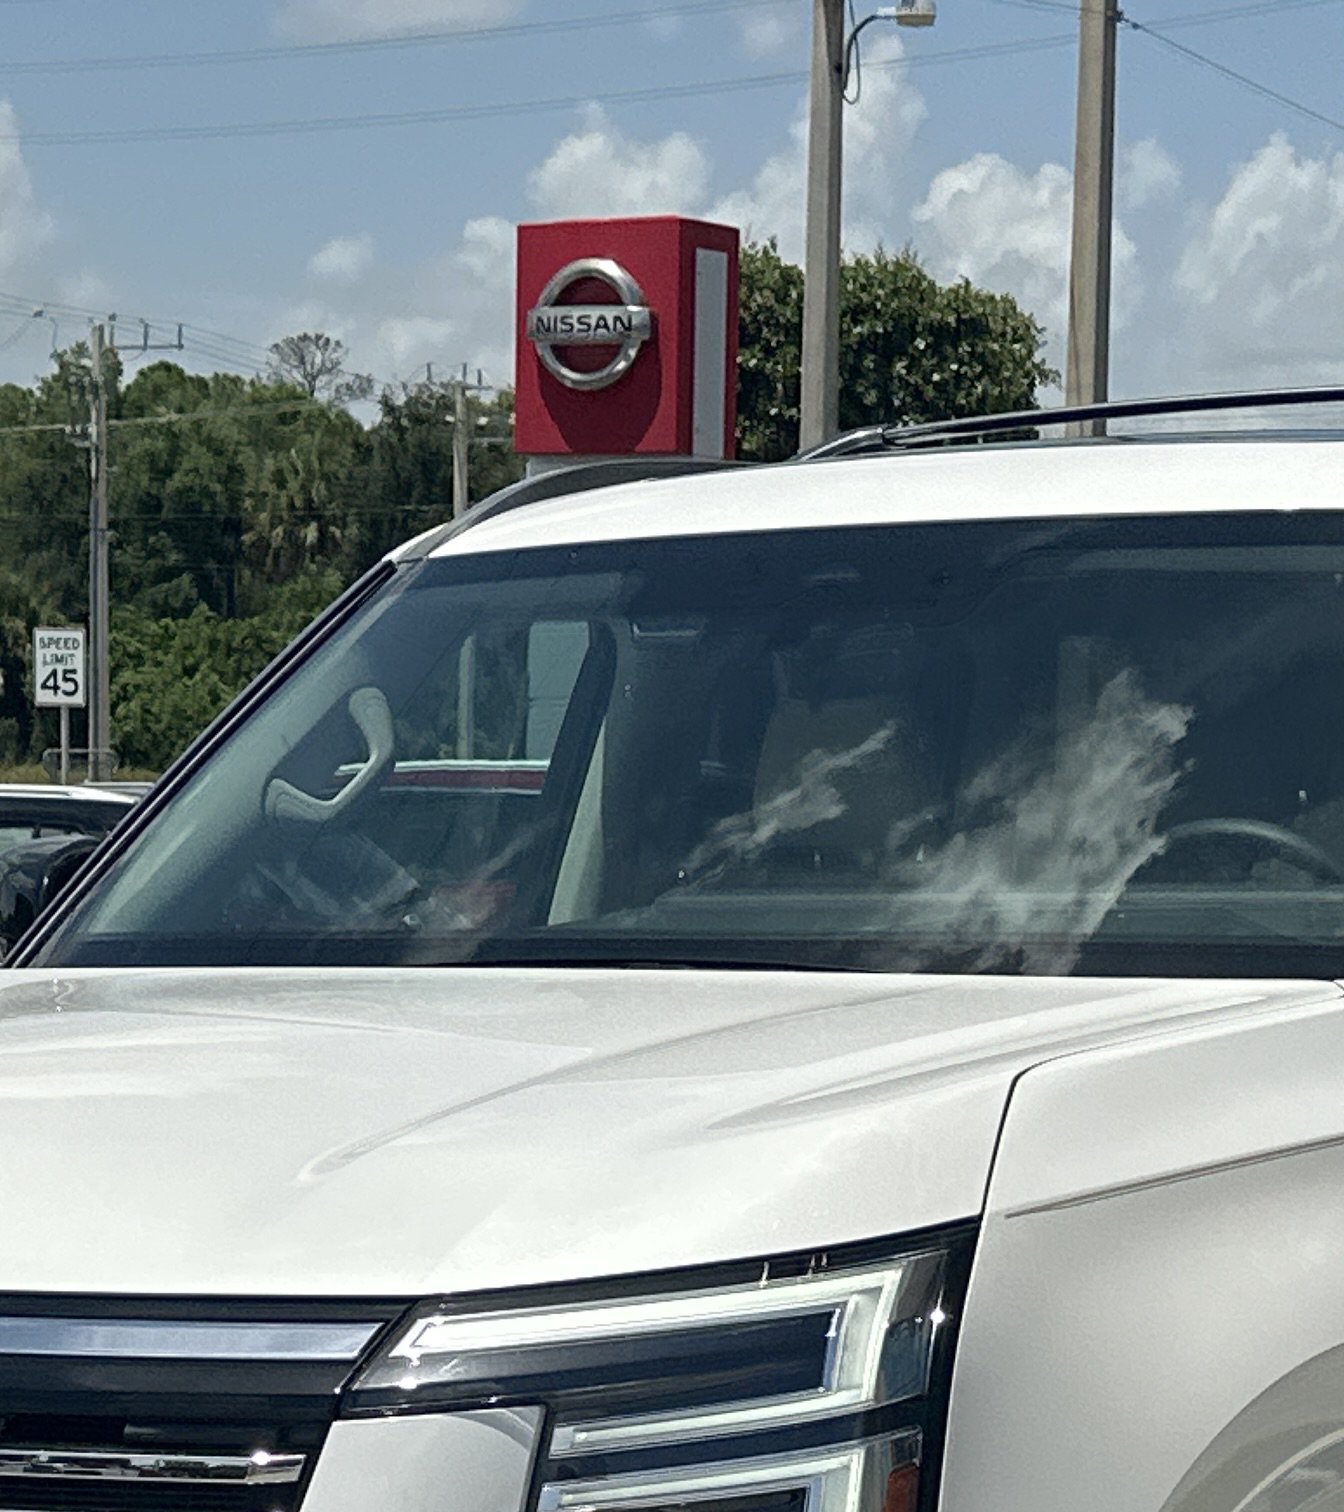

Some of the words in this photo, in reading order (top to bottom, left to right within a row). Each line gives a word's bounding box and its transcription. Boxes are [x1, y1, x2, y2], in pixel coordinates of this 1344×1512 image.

[536, 314, 633, 335] NISSAN
[39, 637, 80, 650] SPEED
[43, 653, 75, 667] LIMIT
[40, 668, 79, 697] 45
